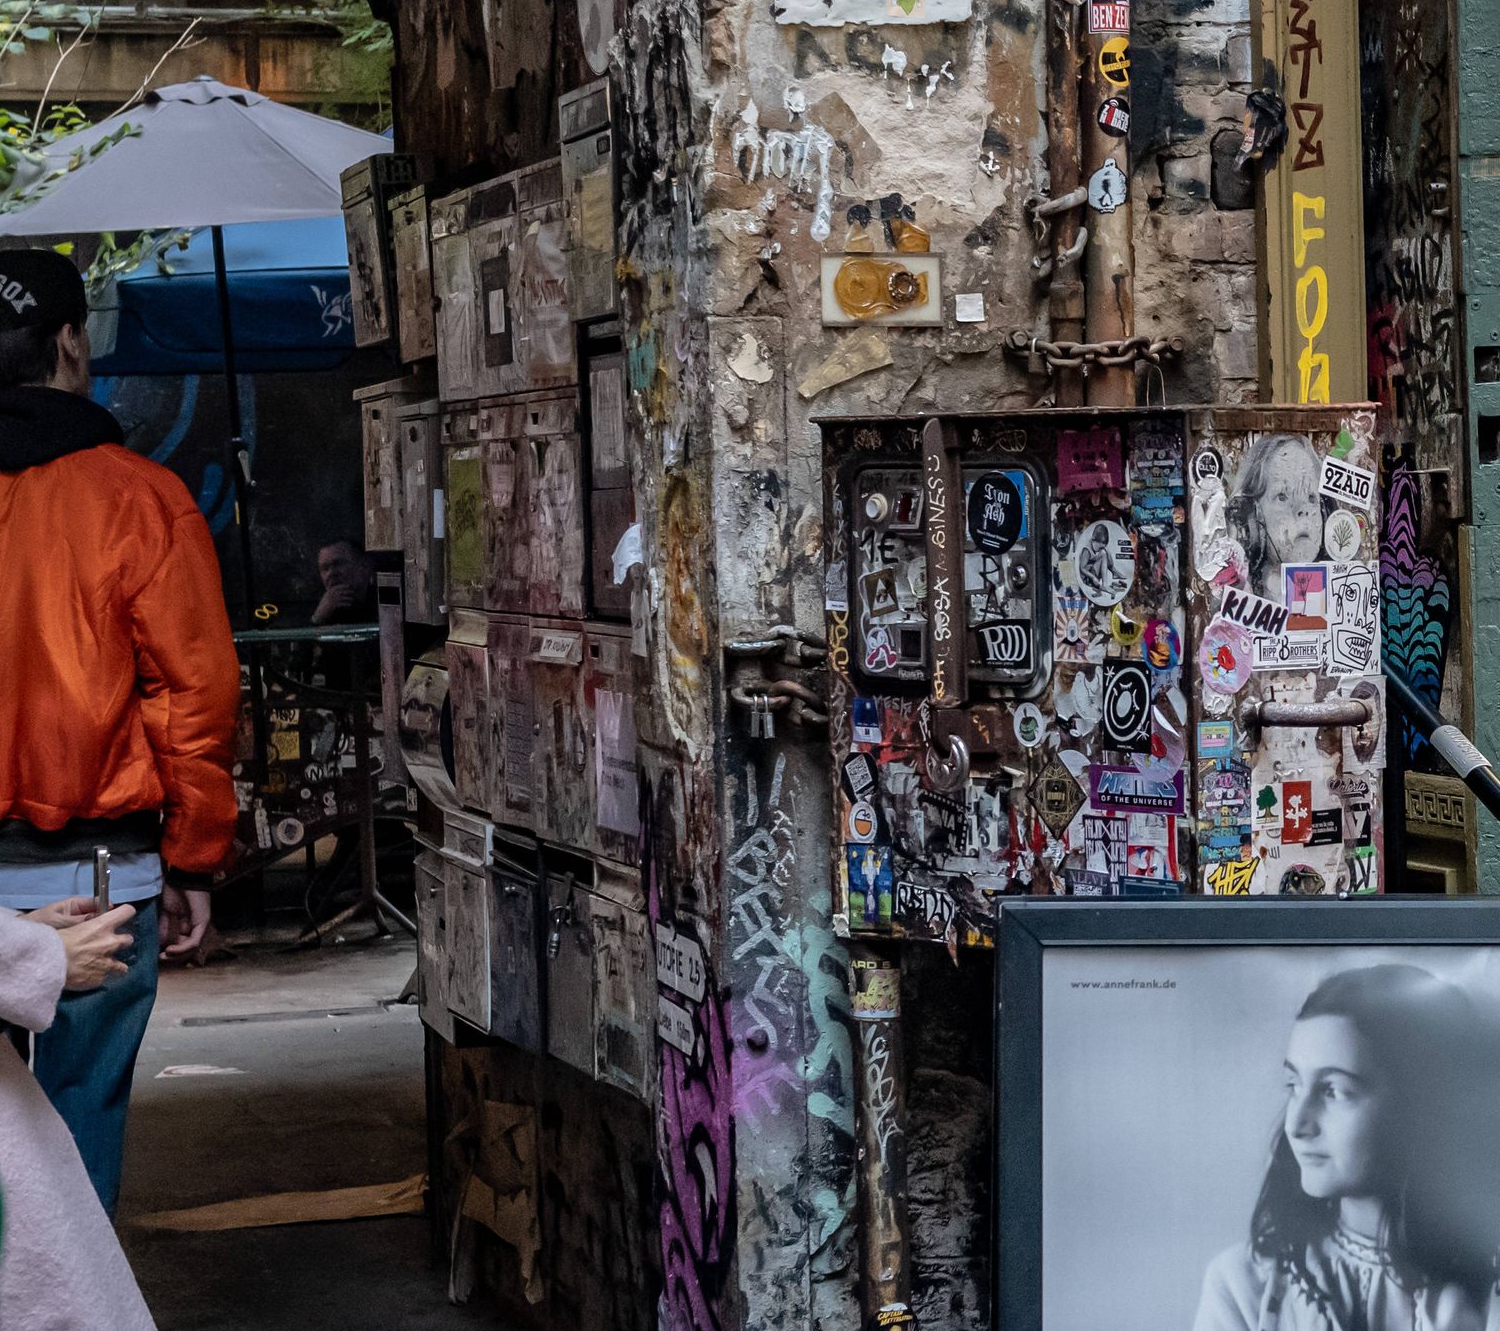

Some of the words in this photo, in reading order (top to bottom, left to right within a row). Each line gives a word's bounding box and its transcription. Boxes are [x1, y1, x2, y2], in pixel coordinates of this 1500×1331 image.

[1221, 590, 1288, 635] KIJAH
[1253, 636, 1277, 662] TRIPP
[1279, 636, 1318, 661] BROTHERS
[1101, 795, 1112, 803] OF
[1114, 796, 1130, 804] THE
[1133, 797, 1173, 807] UNIVERSE
[1070, 979, 1177, 989] www.annefrank.de
